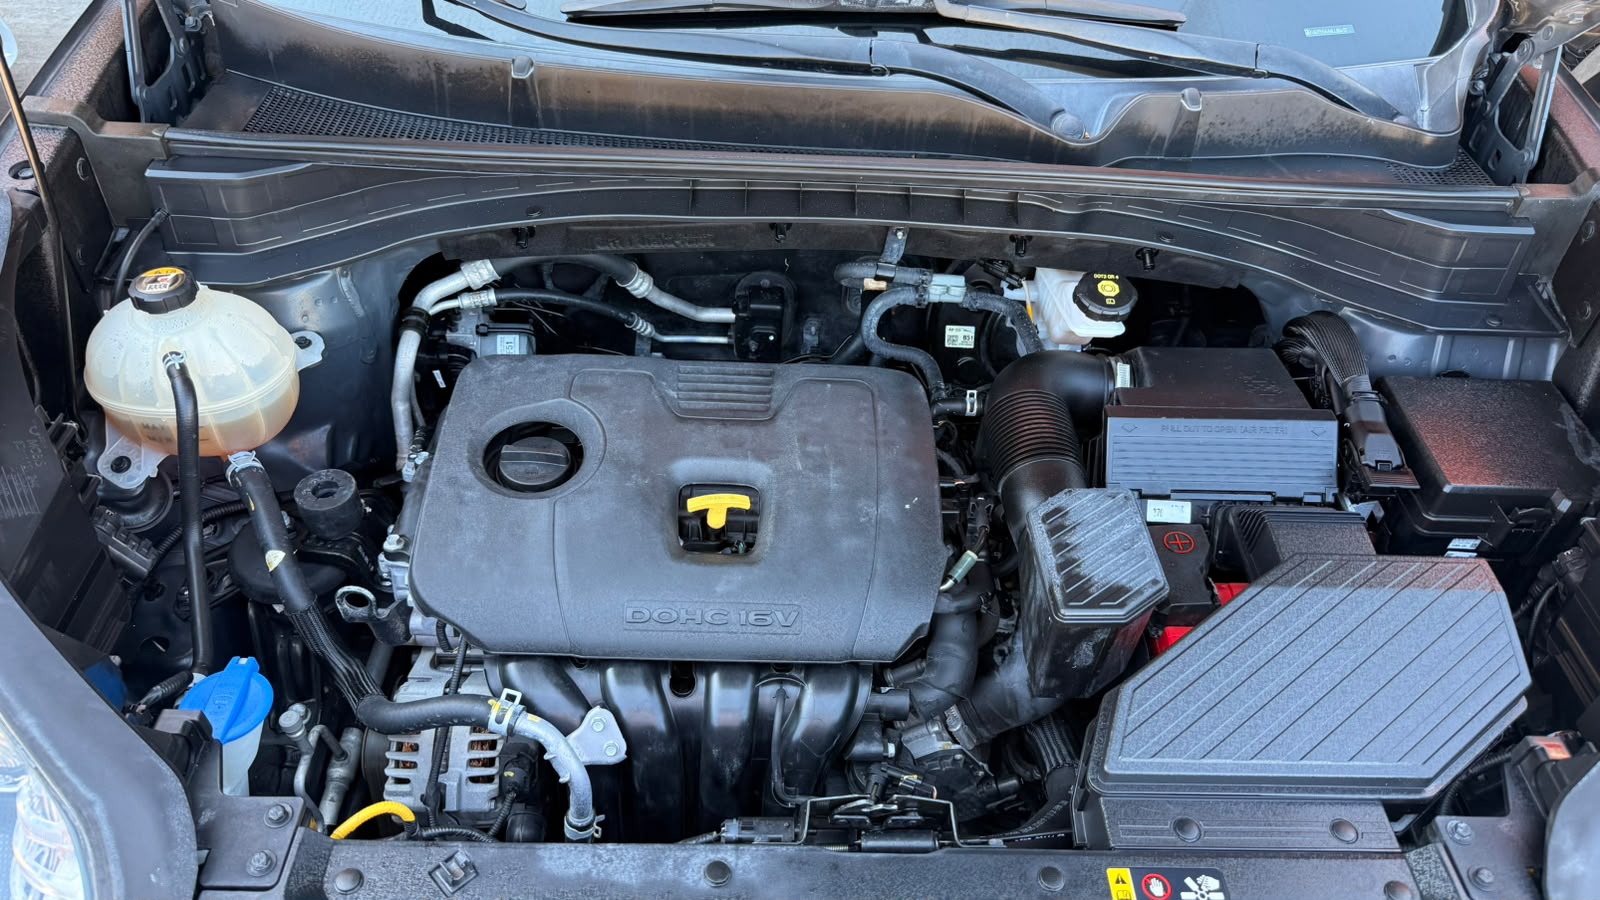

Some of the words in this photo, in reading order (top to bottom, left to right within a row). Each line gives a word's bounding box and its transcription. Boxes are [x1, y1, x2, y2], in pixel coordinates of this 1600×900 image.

[1183, 425, 1200, 433] OUT
[625, 606, 729, 626] DOHC
[738, 609, 800, 628] 16V
